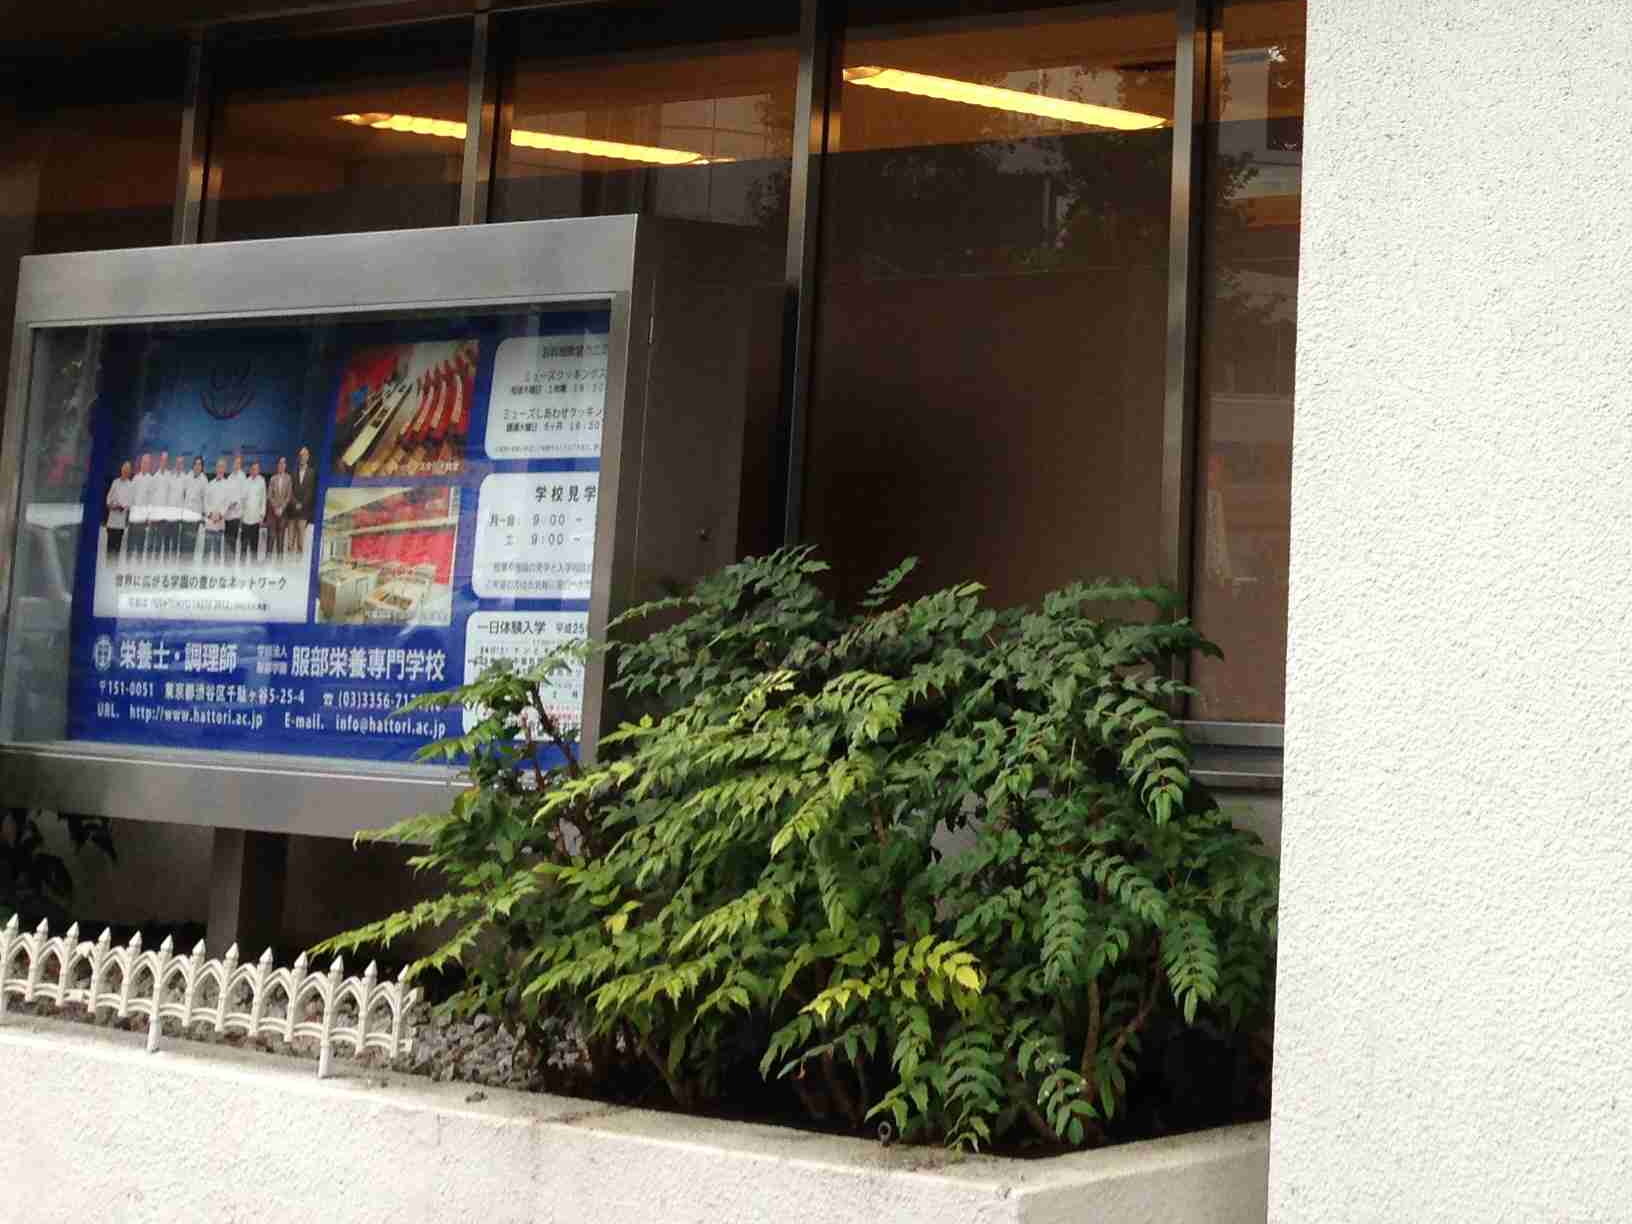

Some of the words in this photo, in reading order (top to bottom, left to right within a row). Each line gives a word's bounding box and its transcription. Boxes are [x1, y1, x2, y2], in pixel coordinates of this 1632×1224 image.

[291, 645, 446, 681] 服部栄養専門学校
